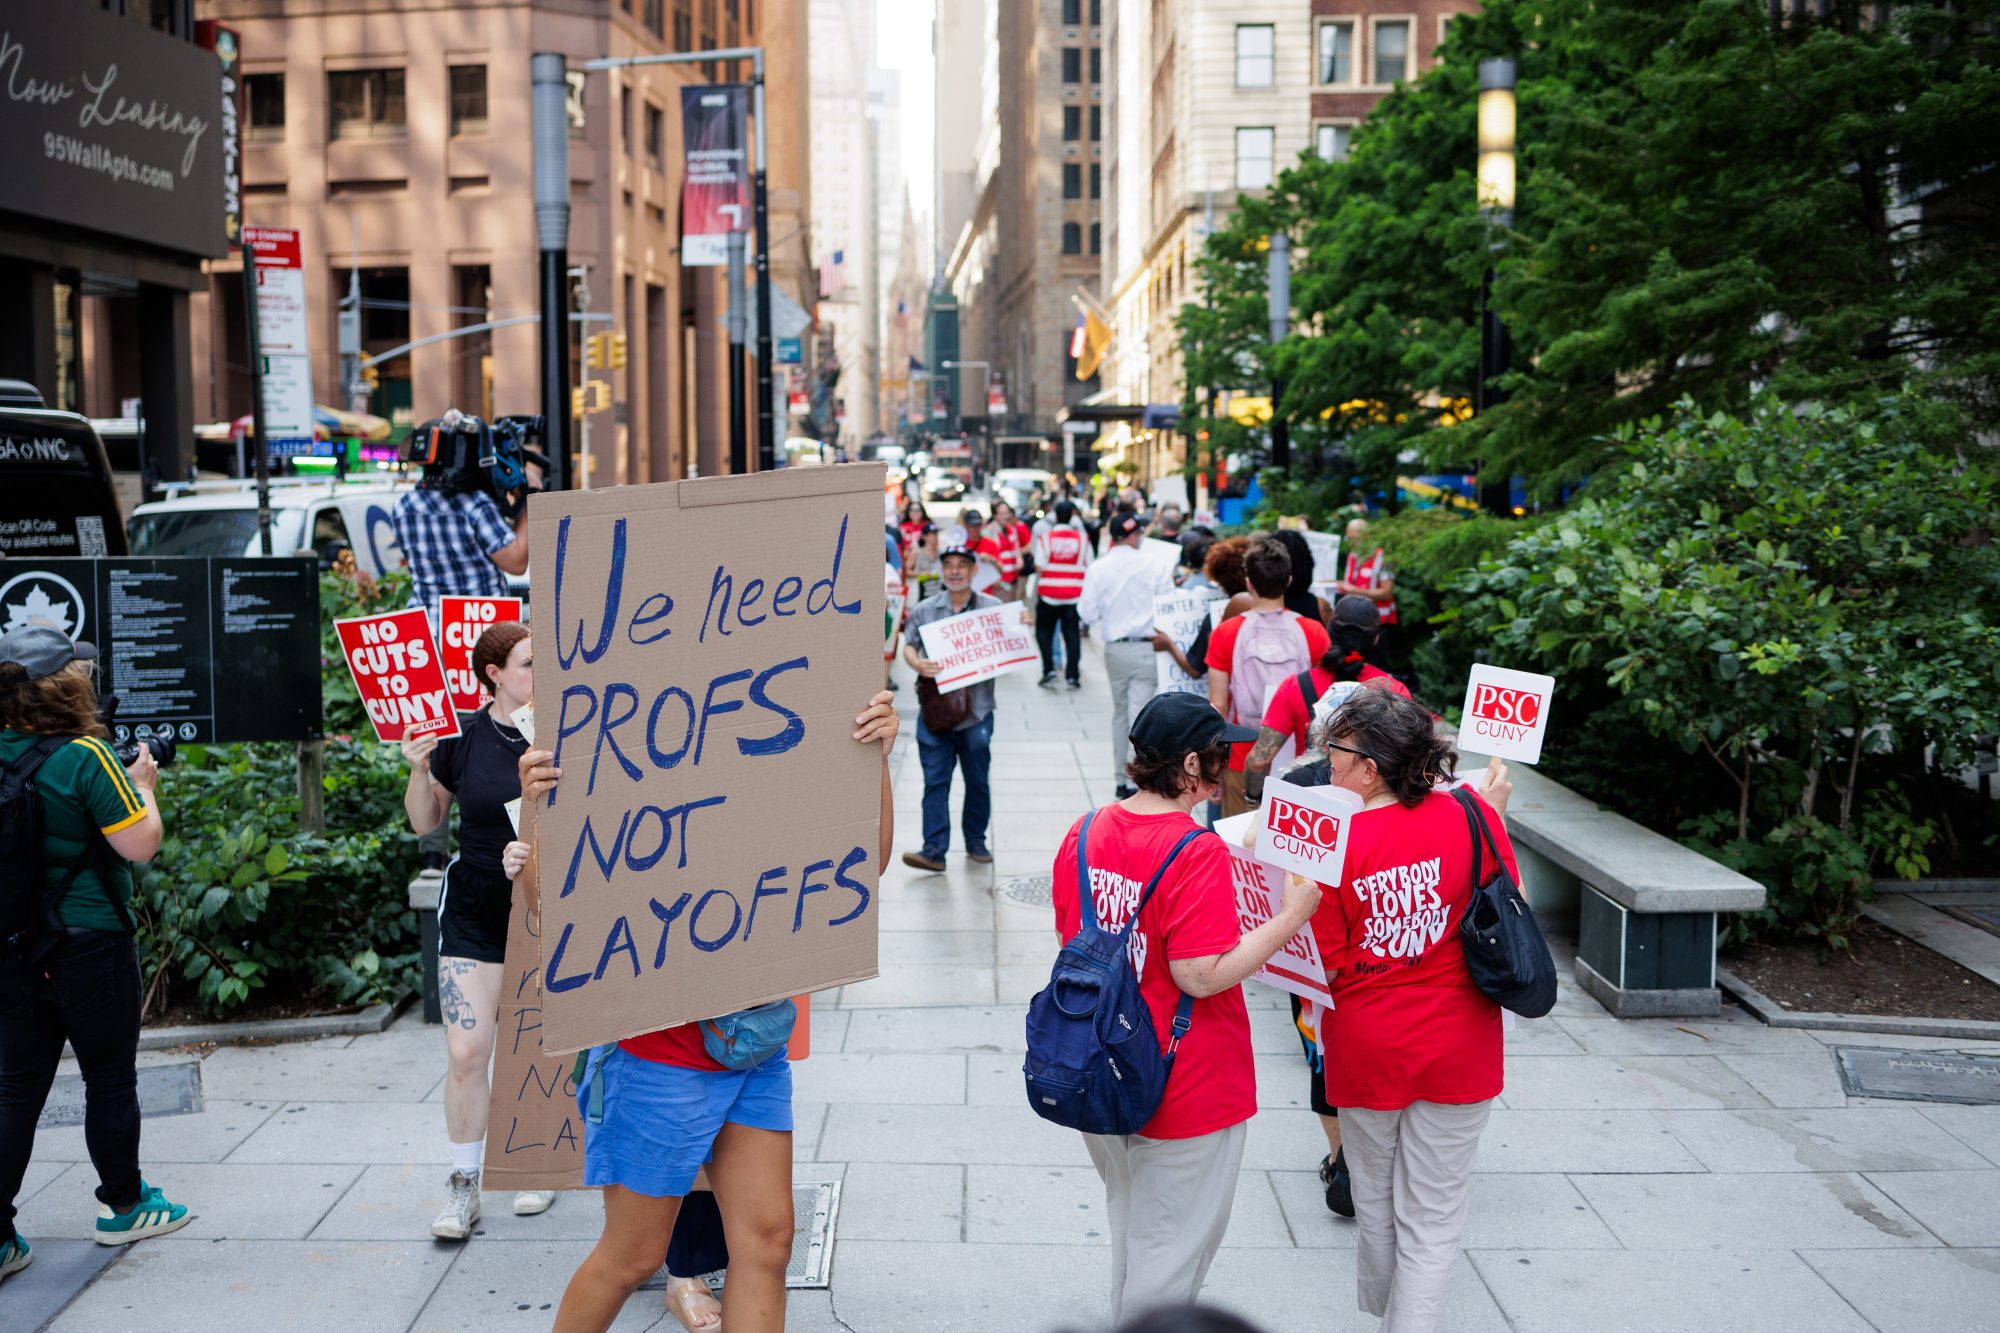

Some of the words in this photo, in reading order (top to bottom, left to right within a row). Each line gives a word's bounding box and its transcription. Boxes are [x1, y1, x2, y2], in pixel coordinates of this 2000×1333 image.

[0, 31, 74, 104] Now
[80, 63, 209, 178] Leasing
[44, 132, 174, 191] 95WallApts.com
[34, 437, 70, 461] NYC
[33, 518, 57, 532] Code
[555, 515, 674, 671] We
[699, 513, 862, 644] need
[463, 602, 497, 622] NO
[940, 618, 975, 639] STOP
[976, 612, 1004, 627] THE
[359, 620, 399, 645] NO
[952, 634, 982, 650] WAR
[985, 626, 1005, 640] ON
[351, 639, 430, 676] CUTS
[377, 674, 409, 697] TO
[366, 689, 446, 725] CUNY
[1473, 684, 1540, 726] PSC
[548, 656, 809, 809] PROFS
[1476, 720, 1528, 743] CUNY
[1269, 798, 1338, 849] PSC
[559, 795, 727, 899] NOT
[1273, 834, 1328, 864] CUNY
[1242, 886, 1273, 920] ON
[1370, 880, 1442, 918] LOVES
[545, 846, 871, 993] LAYOFFS
[1364, 904, 1451, 944] SOMEBODY
